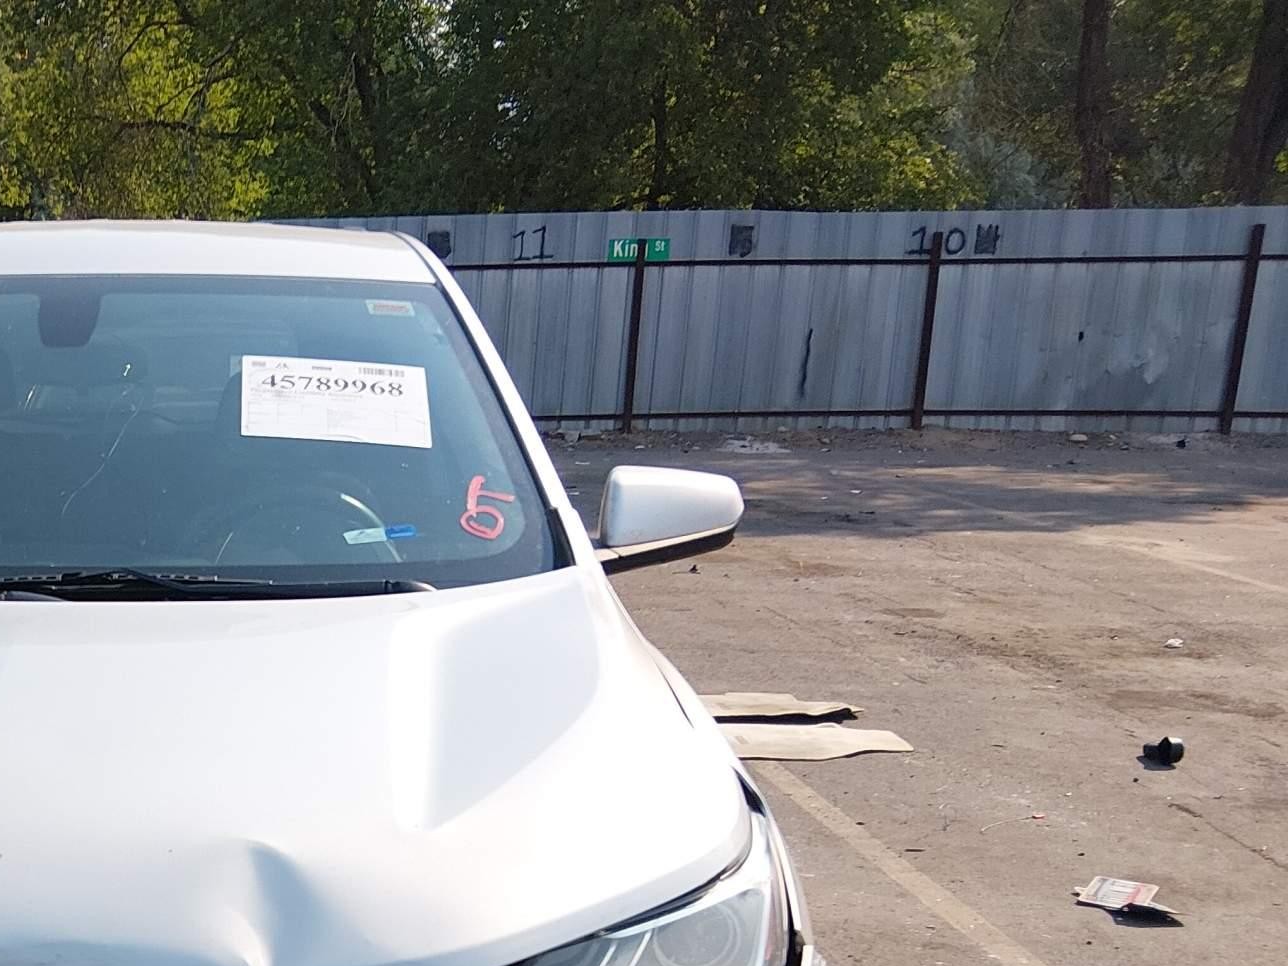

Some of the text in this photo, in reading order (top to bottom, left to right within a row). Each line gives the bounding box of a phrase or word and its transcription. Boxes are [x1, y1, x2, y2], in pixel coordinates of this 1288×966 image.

[512, 225, 554, 261] 11
[613, 240, 666, 259] Kin St
[261, 372, 404, 398] 45789968
